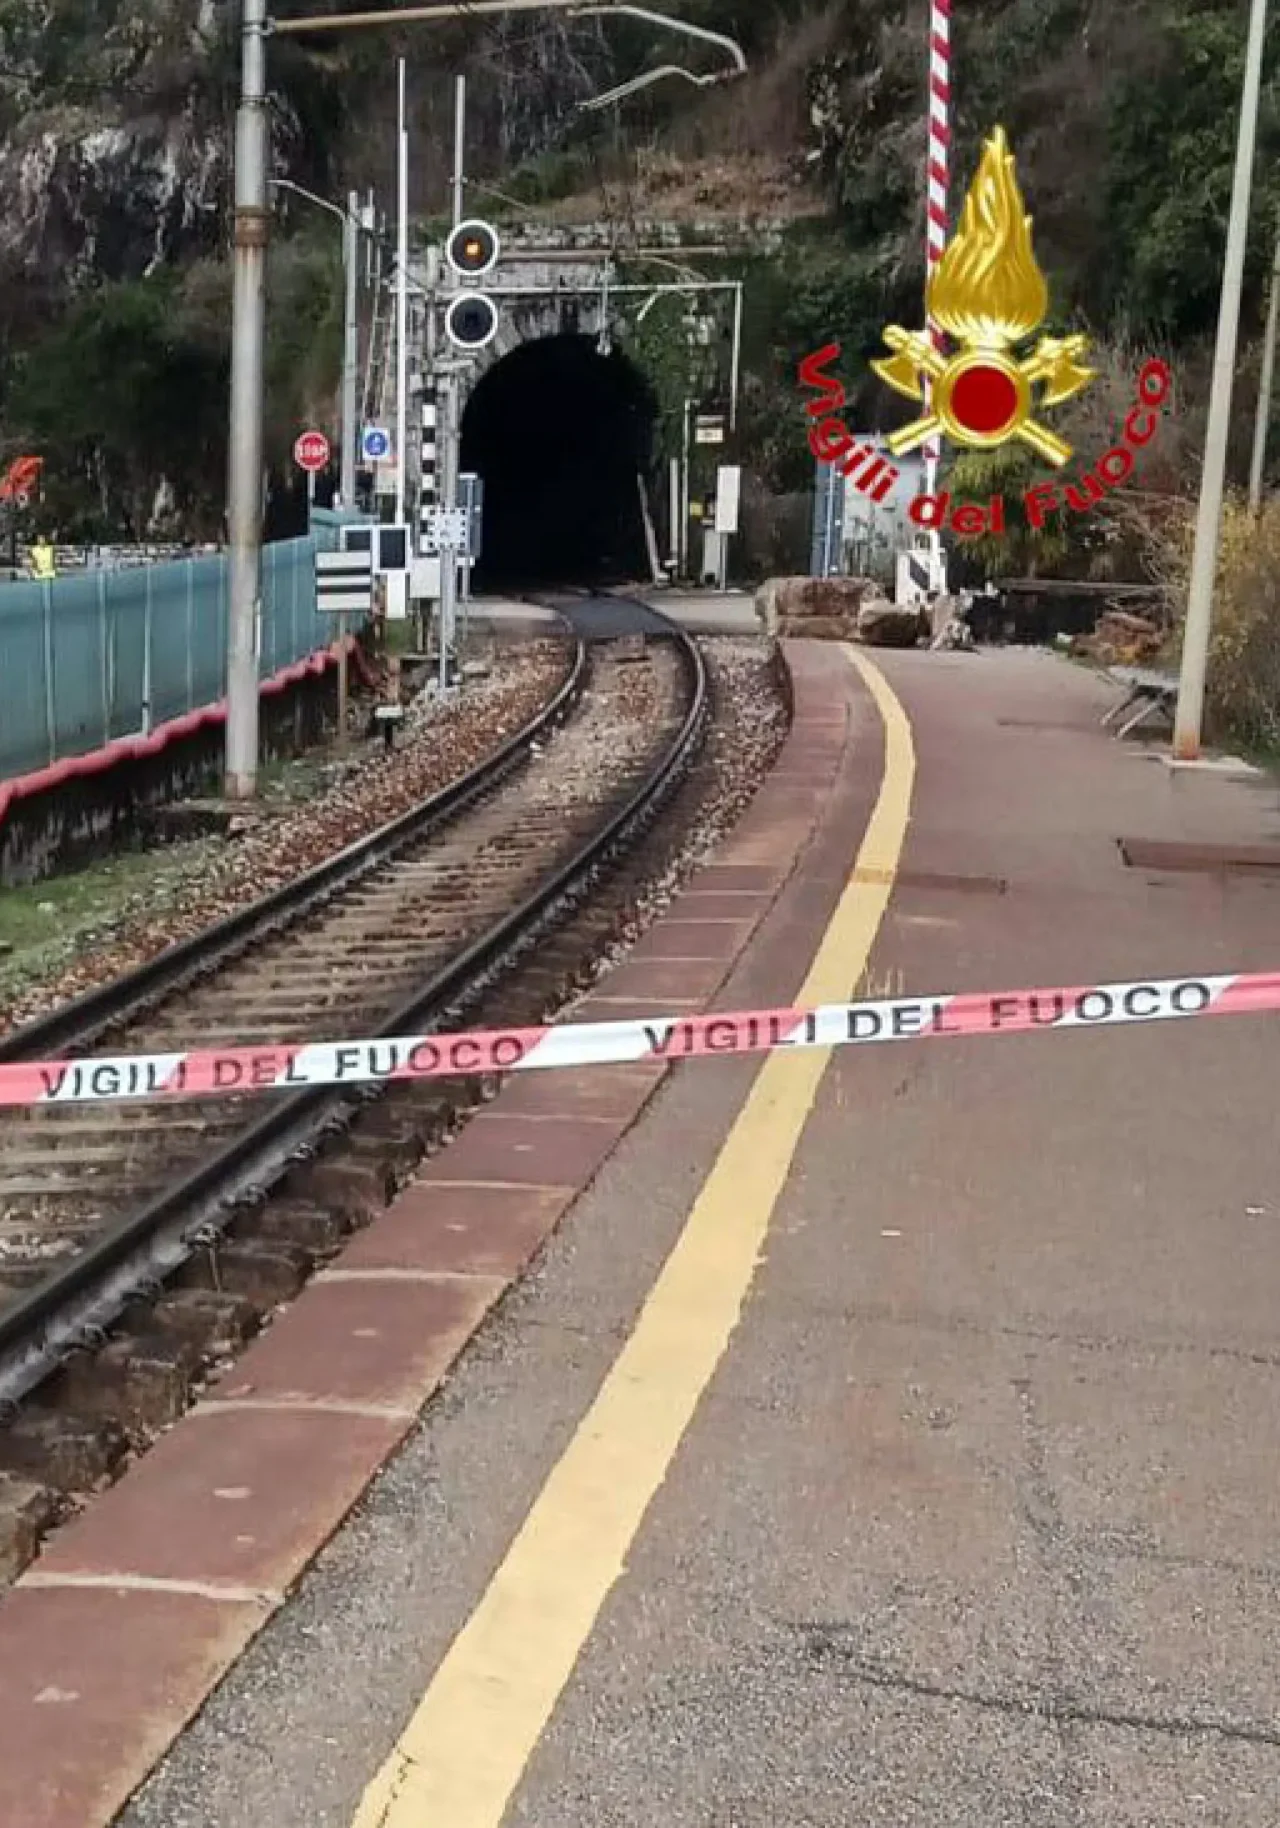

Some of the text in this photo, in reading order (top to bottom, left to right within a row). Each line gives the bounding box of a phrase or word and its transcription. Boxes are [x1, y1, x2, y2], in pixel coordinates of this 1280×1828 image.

[643, 981, 1211, 1055] VIGILI DEL FUOCO
[39, 1036, 524, 1099] VIGILI DEL FUOCO
